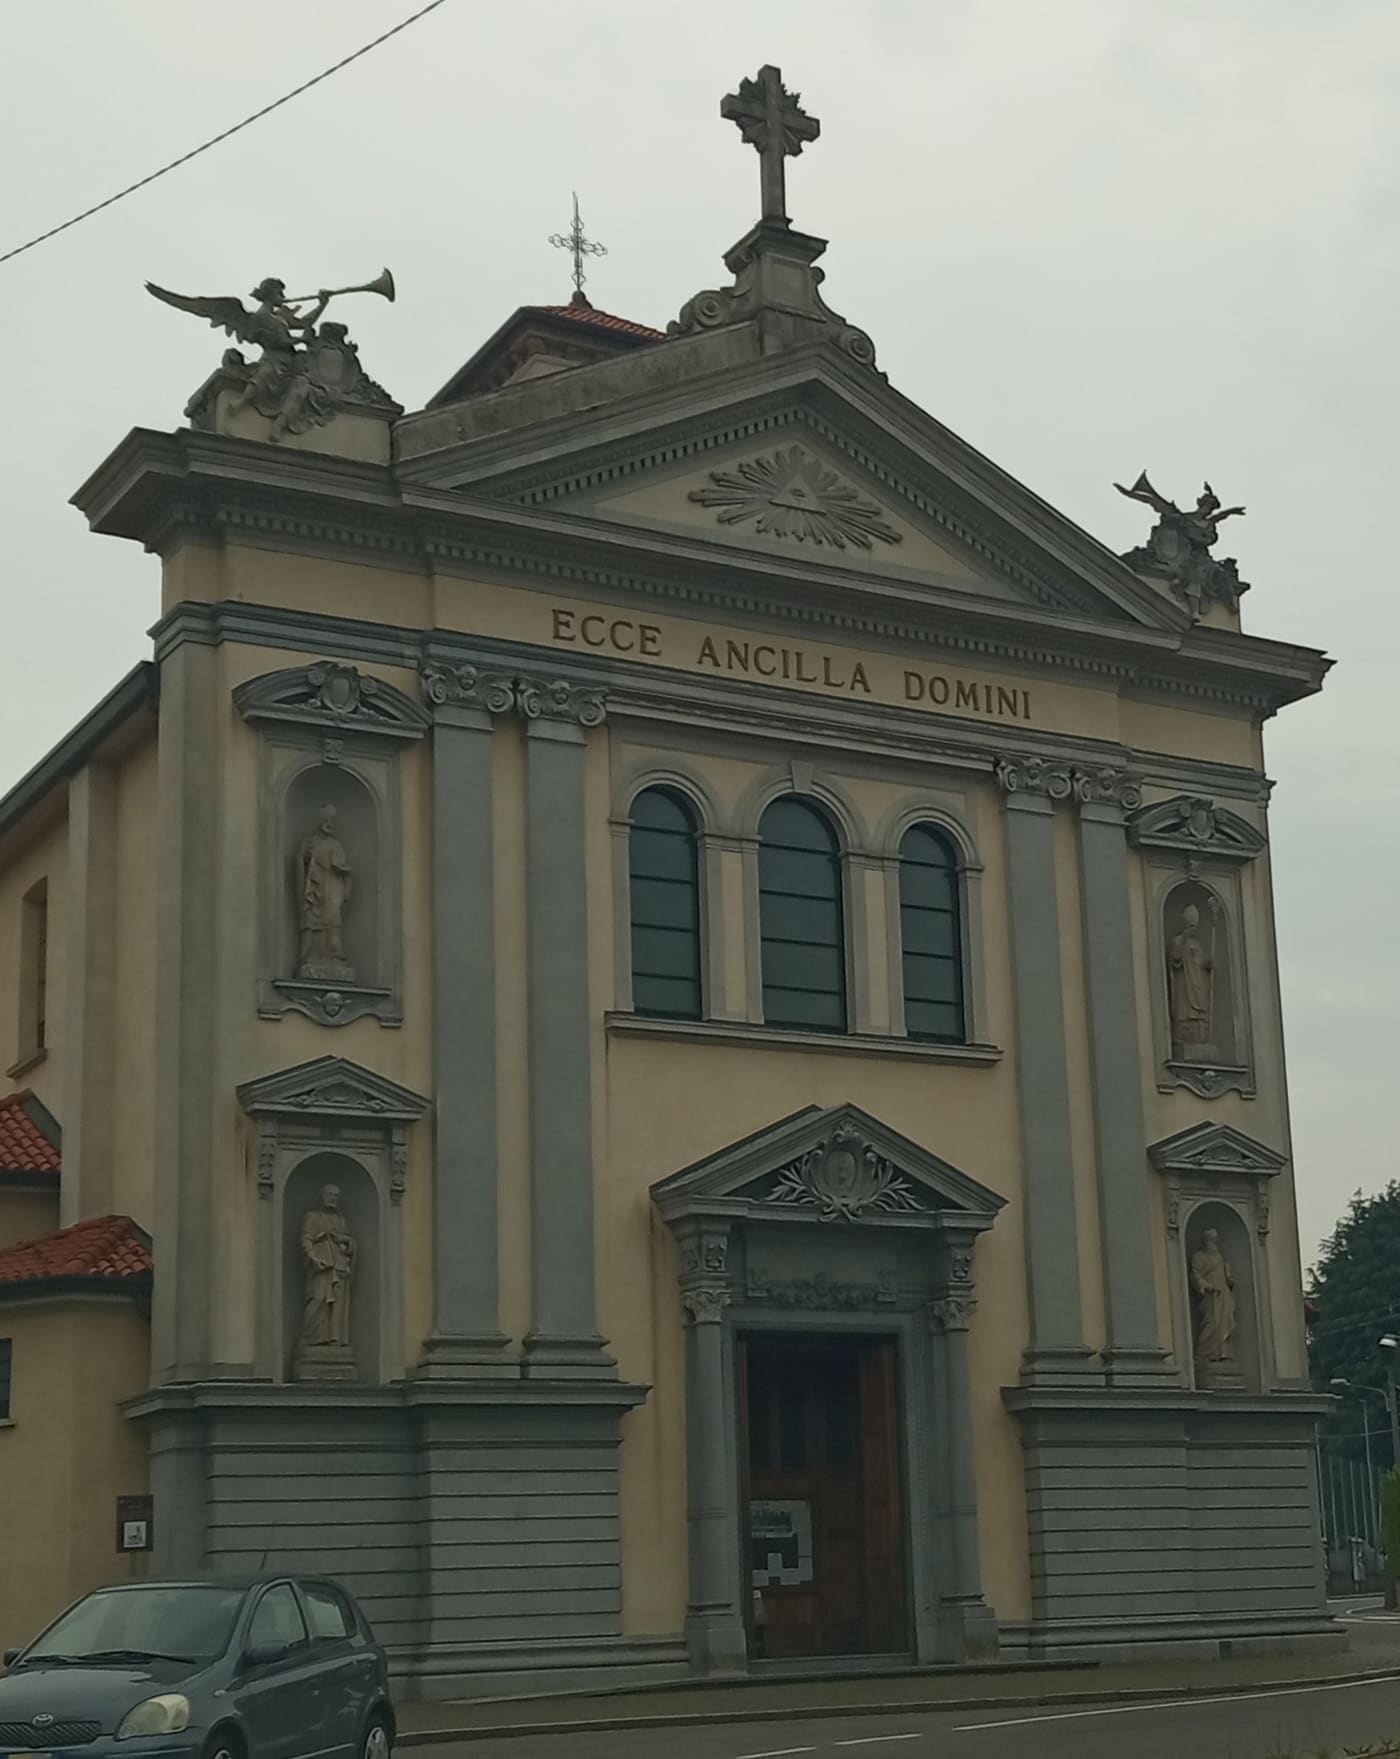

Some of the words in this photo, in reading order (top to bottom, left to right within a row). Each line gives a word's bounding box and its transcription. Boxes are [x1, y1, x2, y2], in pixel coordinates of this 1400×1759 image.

[552, 609, 663, 656] ECCE
[697, 636, 871, 692] ANCILLA
[904, 671, 1031, 719] DOMINI
